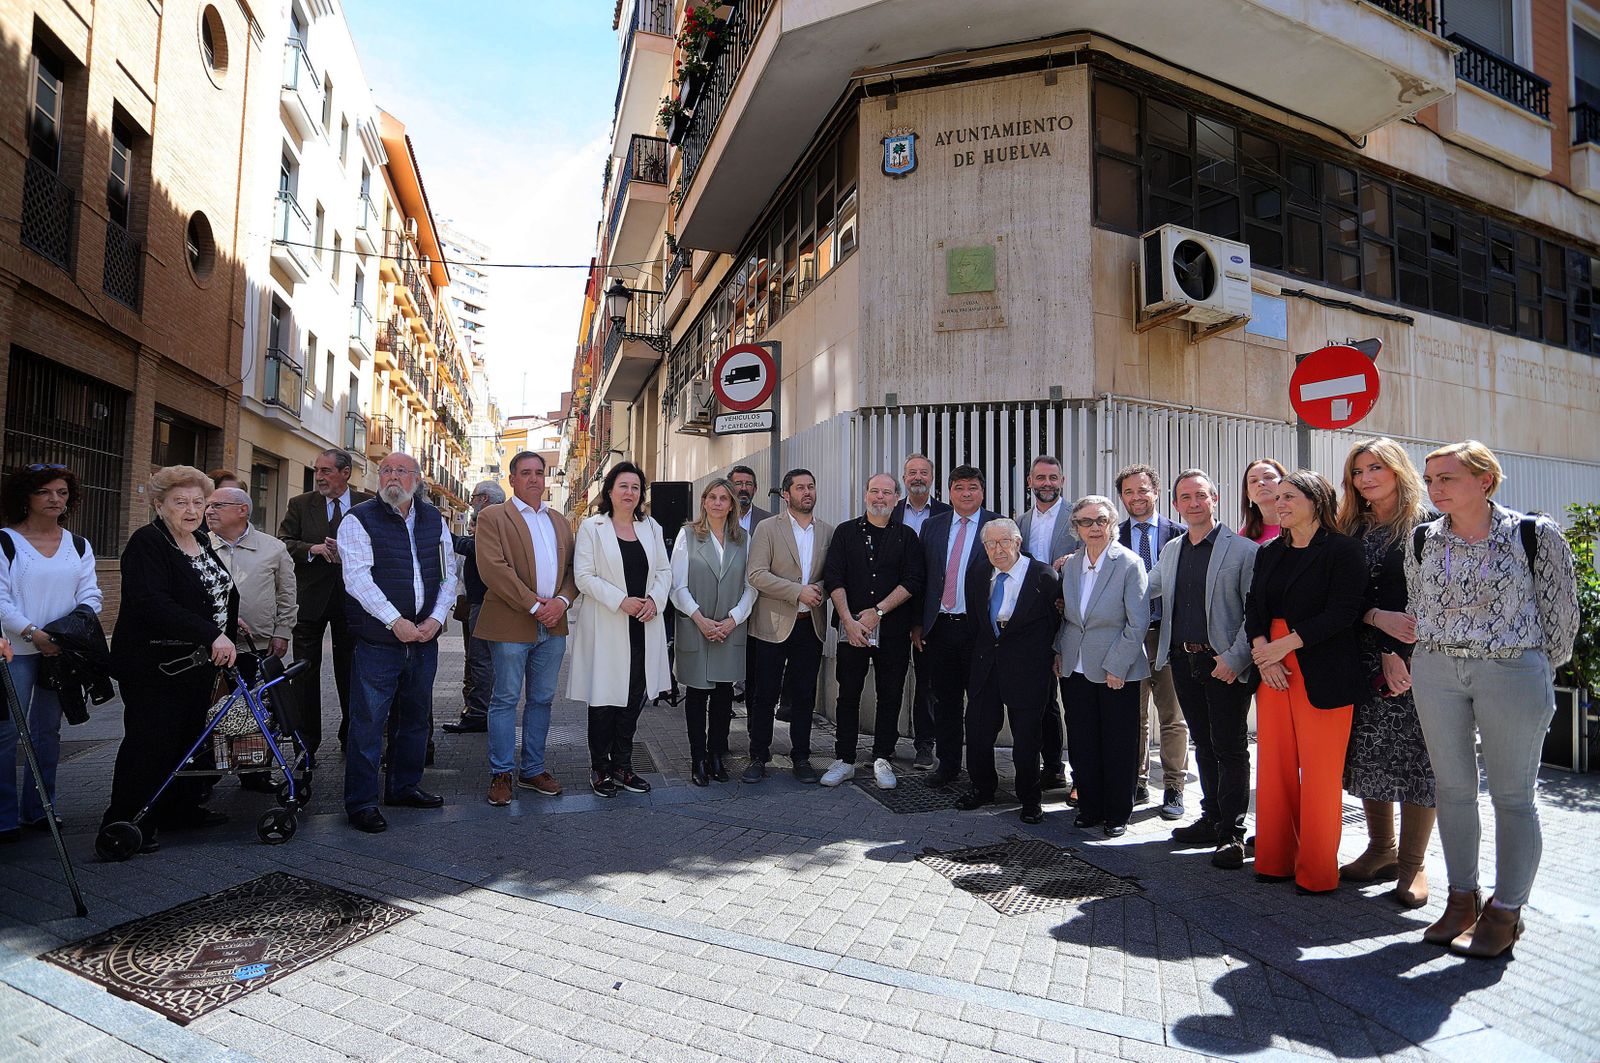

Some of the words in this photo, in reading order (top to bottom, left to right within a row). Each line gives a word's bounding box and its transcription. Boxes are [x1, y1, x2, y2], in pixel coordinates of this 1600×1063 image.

[935, 116, 1073, 146] AYUNTAMIENTO
[954, 151, 975, 168] DE
[984, 142, 1051, 165] HUELVA
